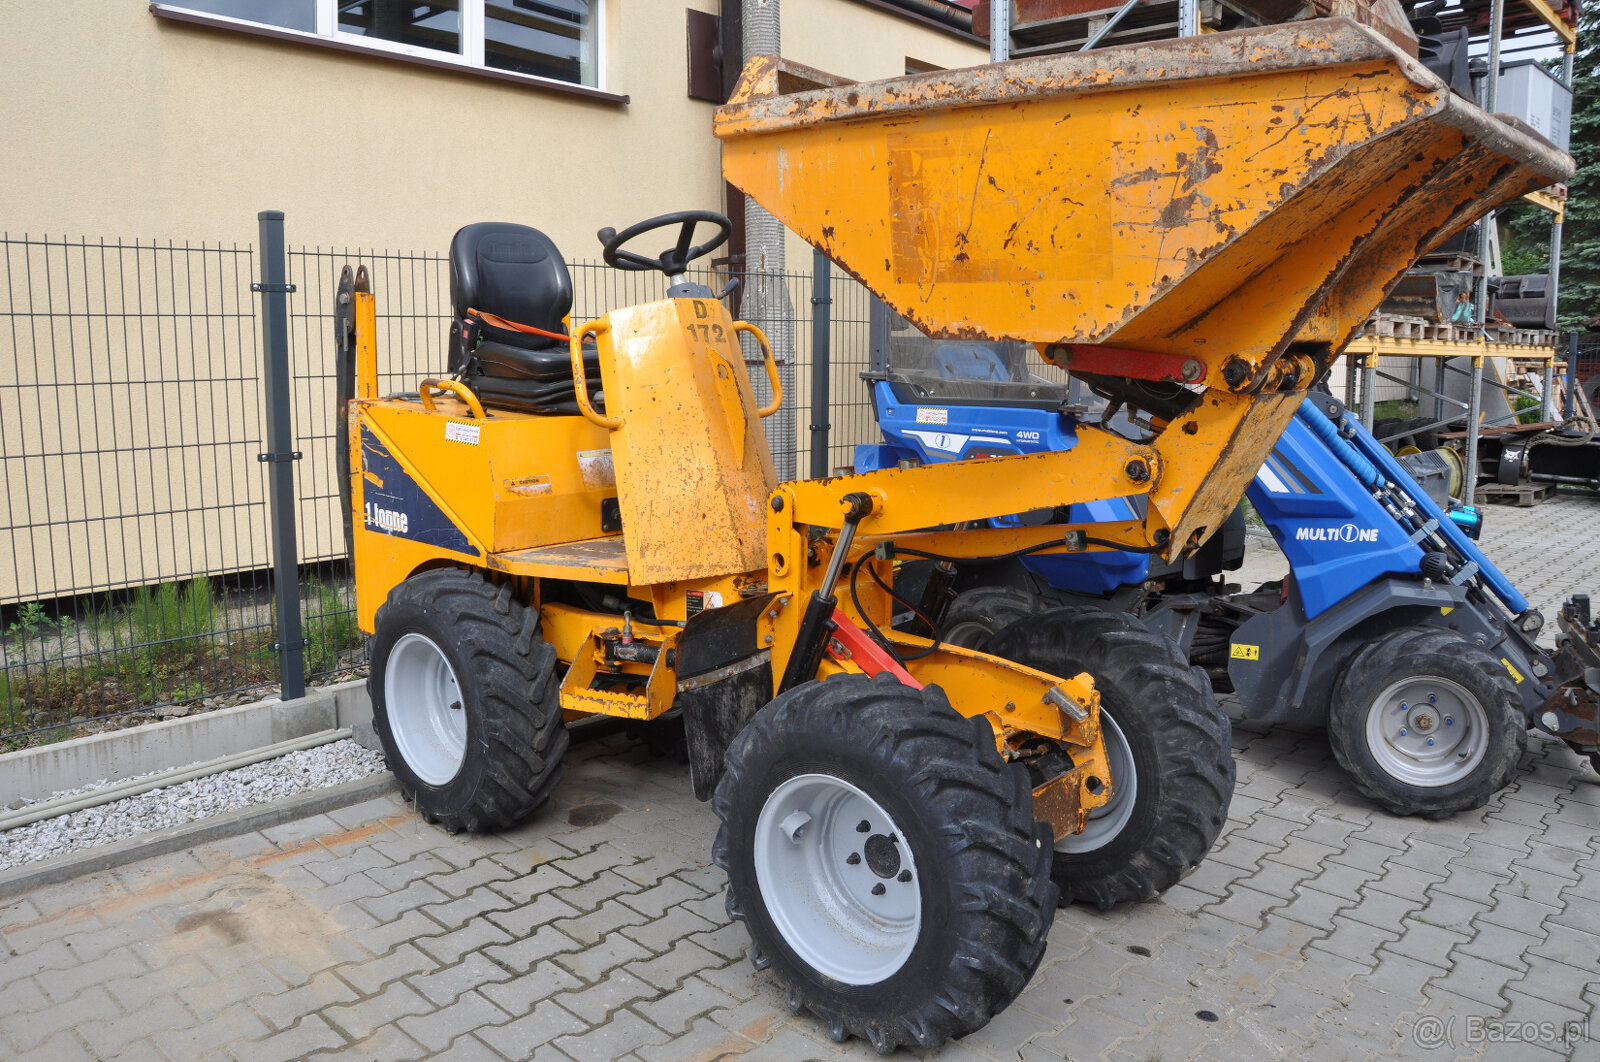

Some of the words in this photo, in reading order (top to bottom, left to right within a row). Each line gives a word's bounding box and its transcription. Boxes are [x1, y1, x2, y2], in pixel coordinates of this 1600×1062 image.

[693, 300, 708, 319] D
[687, 323, 727, 343] 172
[1016, 431, 1039, 440] 4WD
[365, 502, 372, 526] 1
[374, 503, 408, 533] tonne
